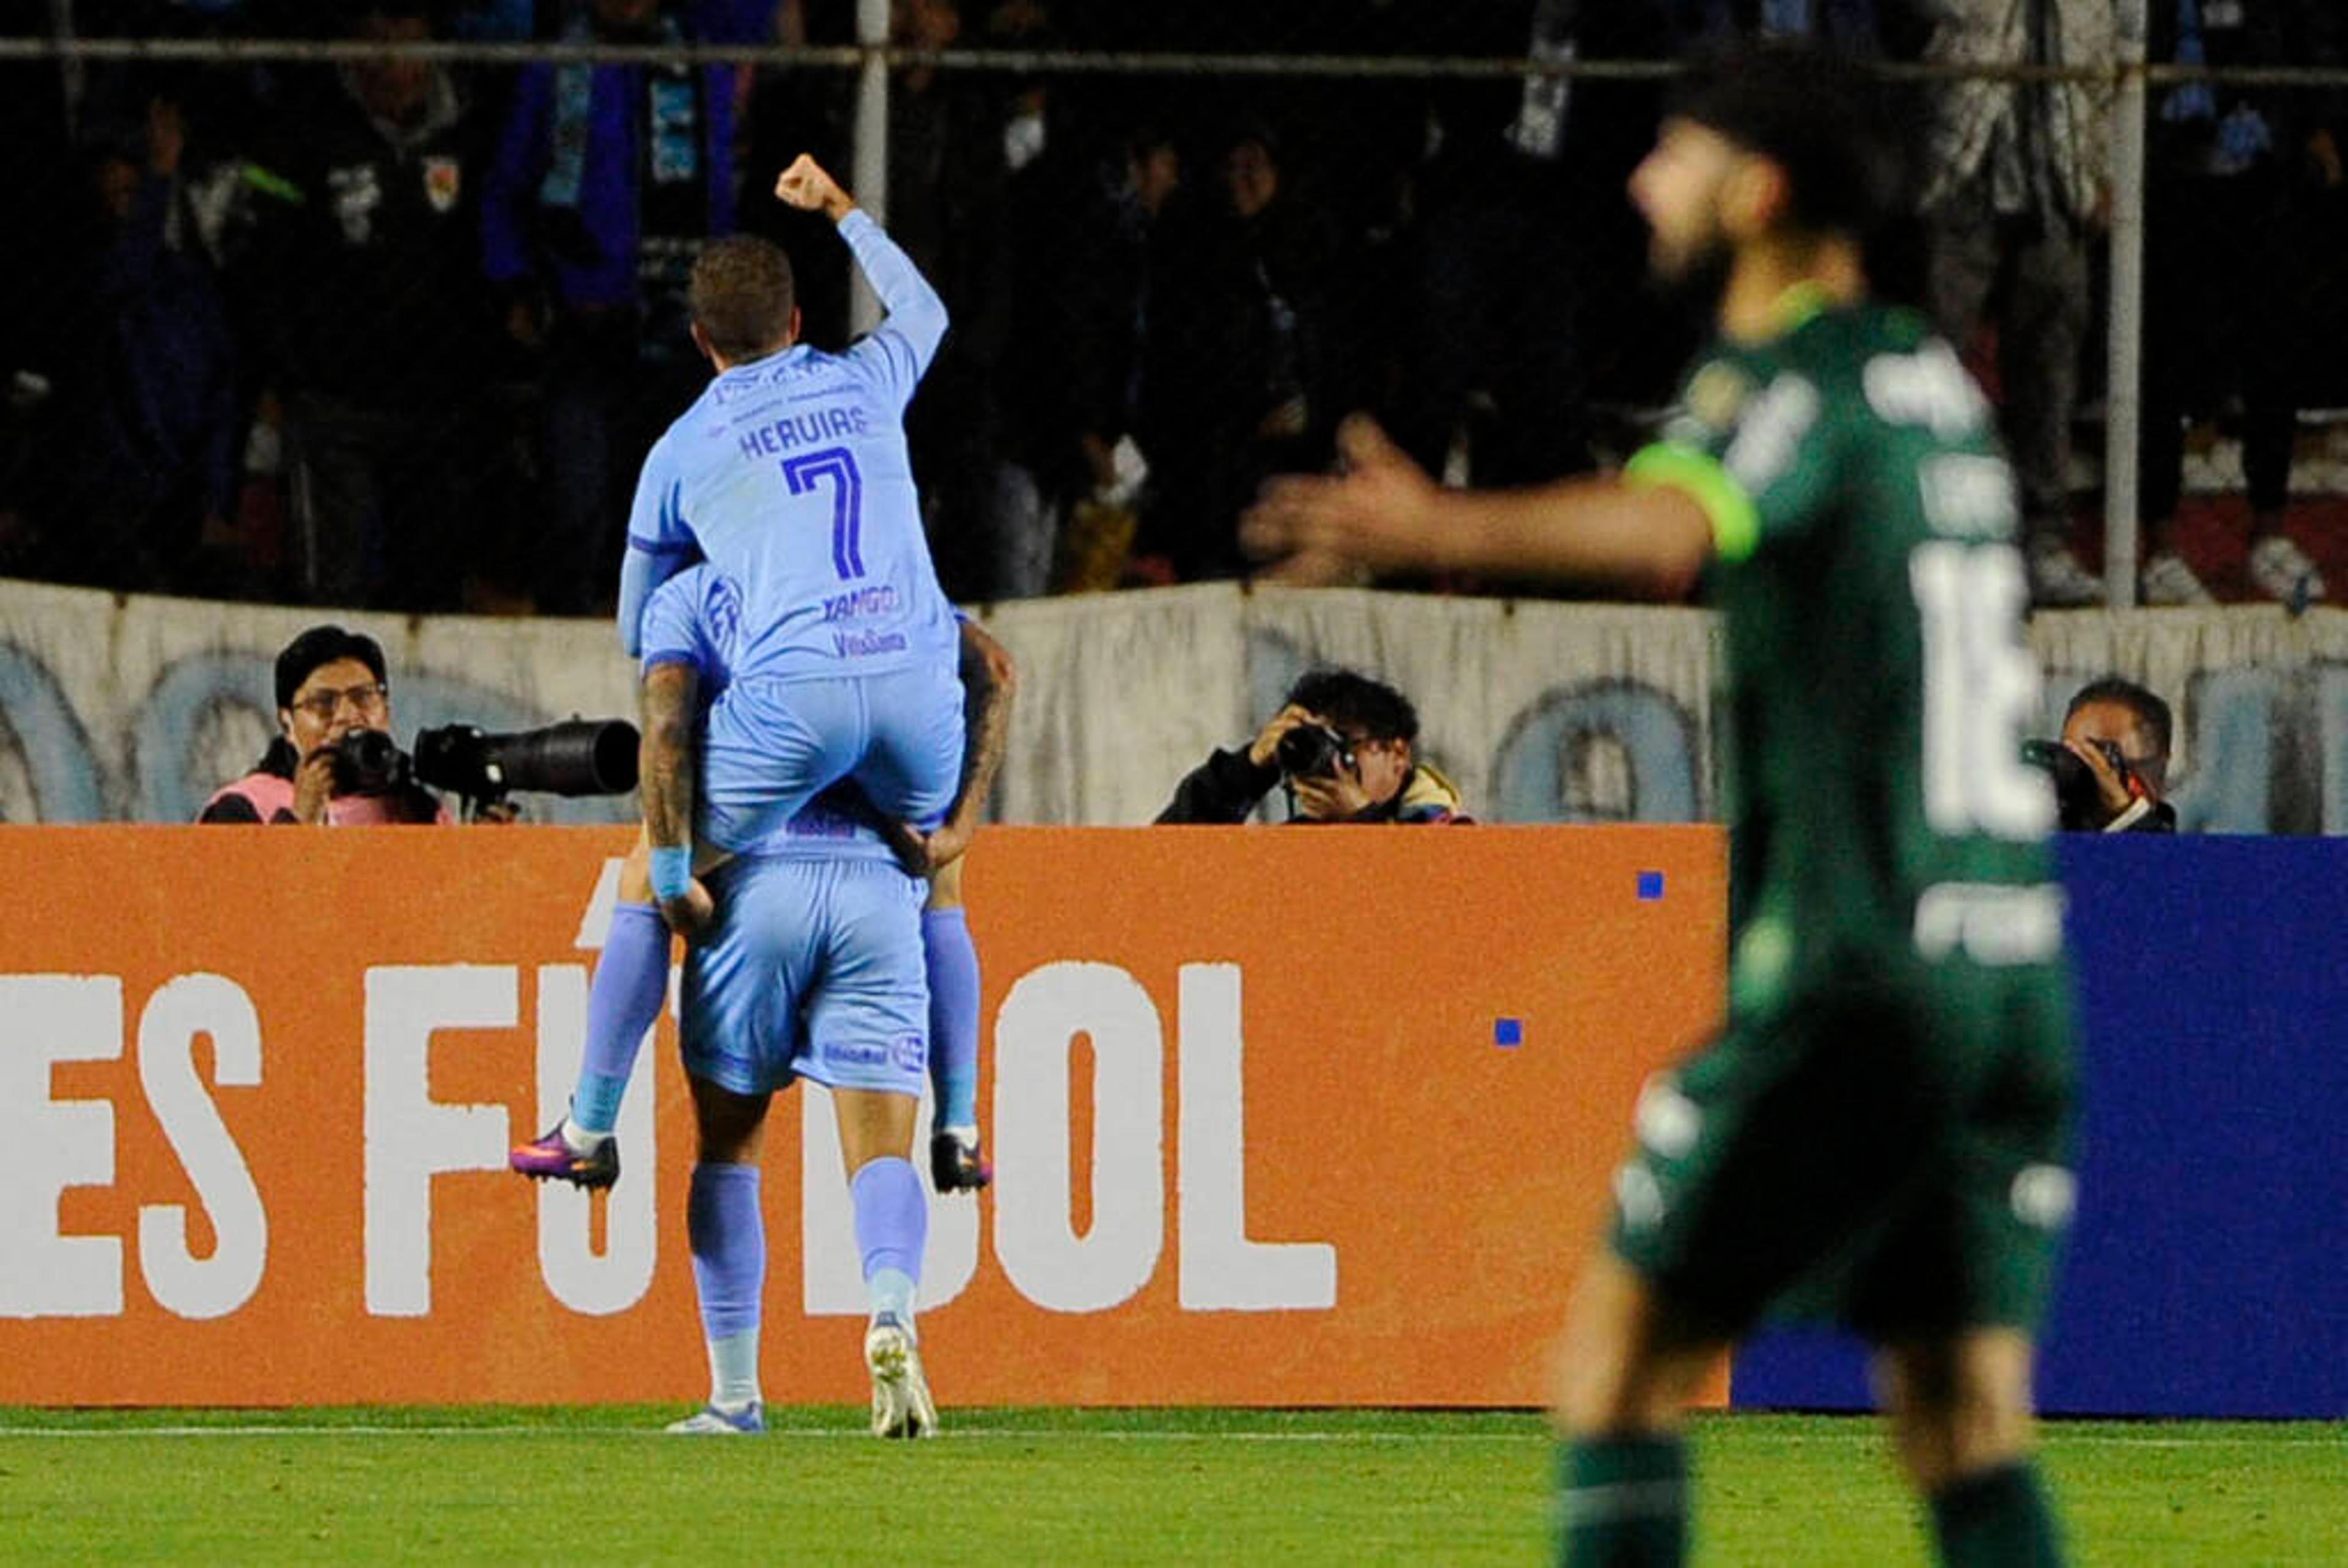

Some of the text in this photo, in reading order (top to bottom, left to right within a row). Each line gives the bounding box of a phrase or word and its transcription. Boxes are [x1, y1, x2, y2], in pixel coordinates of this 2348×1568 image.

[782, 447, 865, 580] 7
[0, 858, 1337, 1319] ES FÚOL
